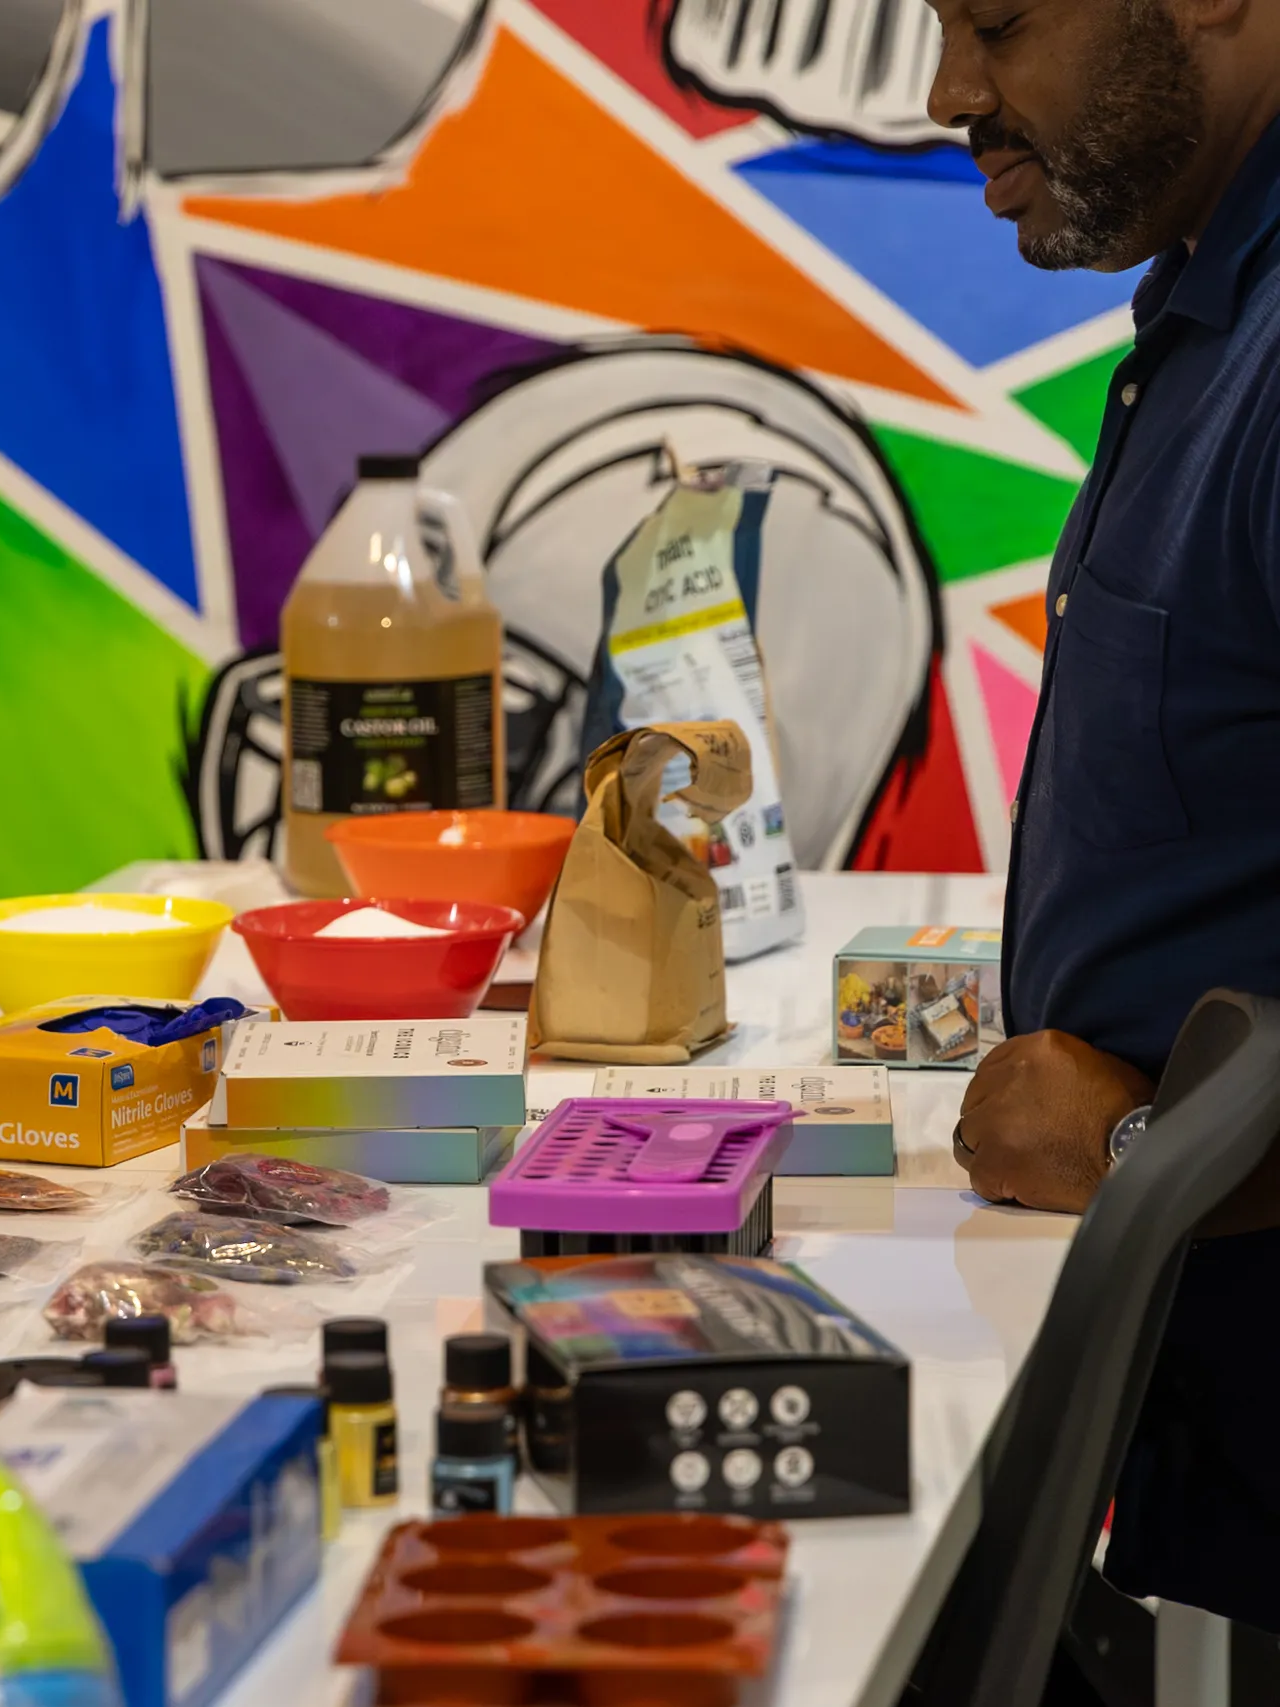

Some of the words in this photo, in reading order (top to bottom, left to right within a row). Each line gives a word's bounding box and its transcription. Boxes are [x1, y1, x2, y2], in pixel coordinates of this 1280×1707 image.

[682, 564, 724, 598] ACID
[340, 718, 407, 738] CASTOR
[408, 716, 439, 736] OIL
[54, 1081, 73, 1100] M
[111, 1099, 152, 1129] Nitrile
[155, 1087, 193, 1113] Gloves
